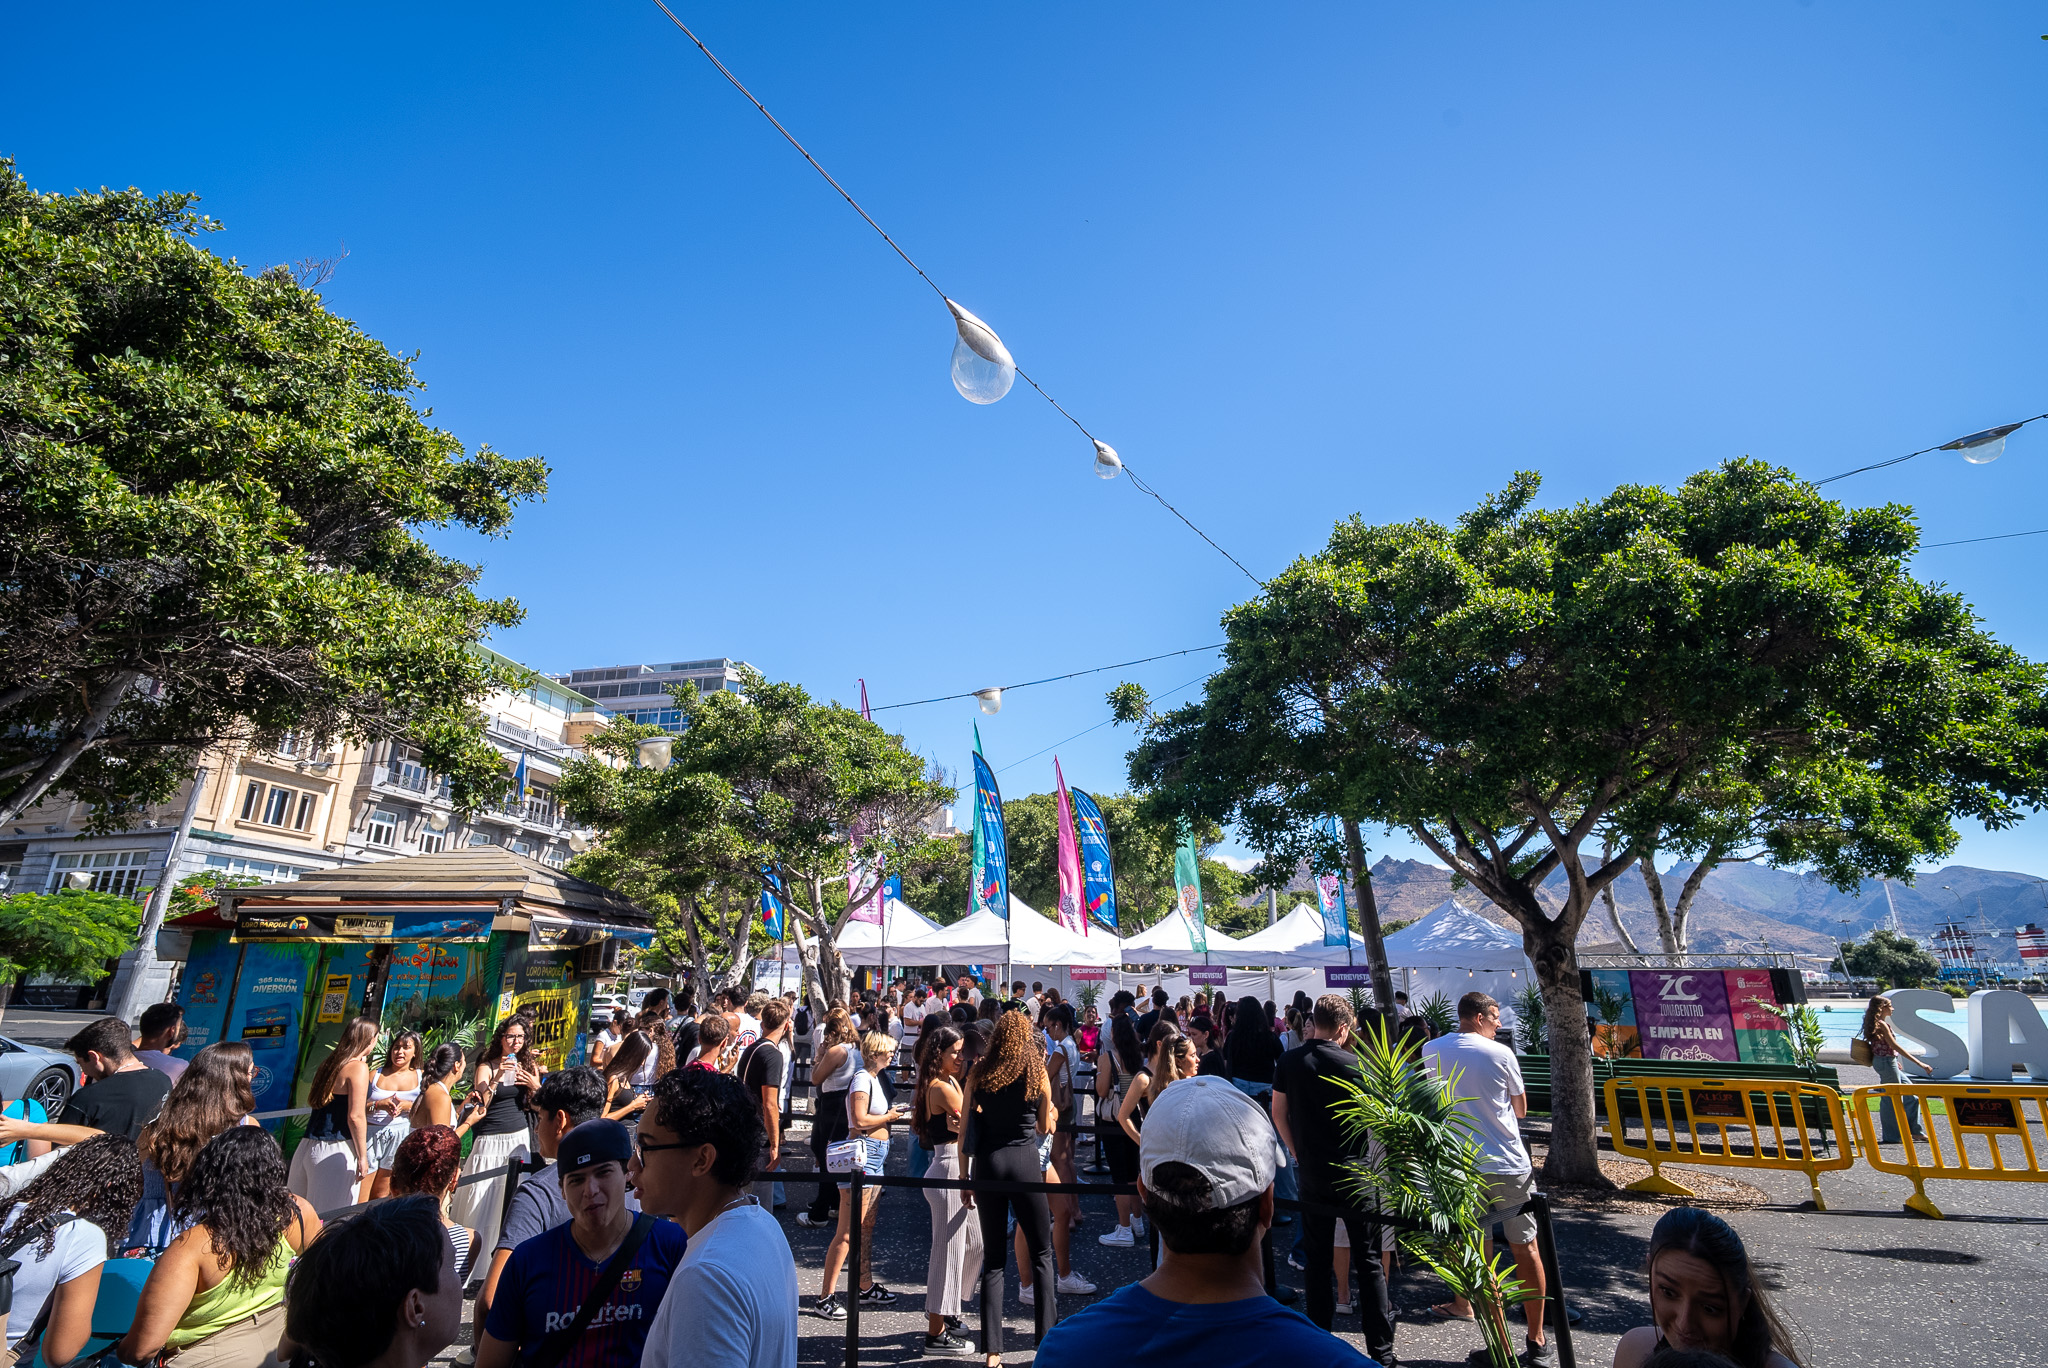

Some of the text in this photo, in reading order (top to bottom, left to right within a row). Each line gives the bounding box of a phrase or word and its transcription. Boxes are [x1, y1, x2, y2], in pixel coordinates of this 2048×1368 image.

[342, 918, 388, 928] TWIN TICKET
[526, 966, 562, 978] LORO PARQUE
[252, 983, 298, 993] DIVERSIÓN
[1655, 974, 1702, 1000] ZC
[532, 1019, 566, 1045] ICKET
[1650, 1026, 1723, 1040] EMPLEA EN
[545, 1302, 642, 1333] Rauten
